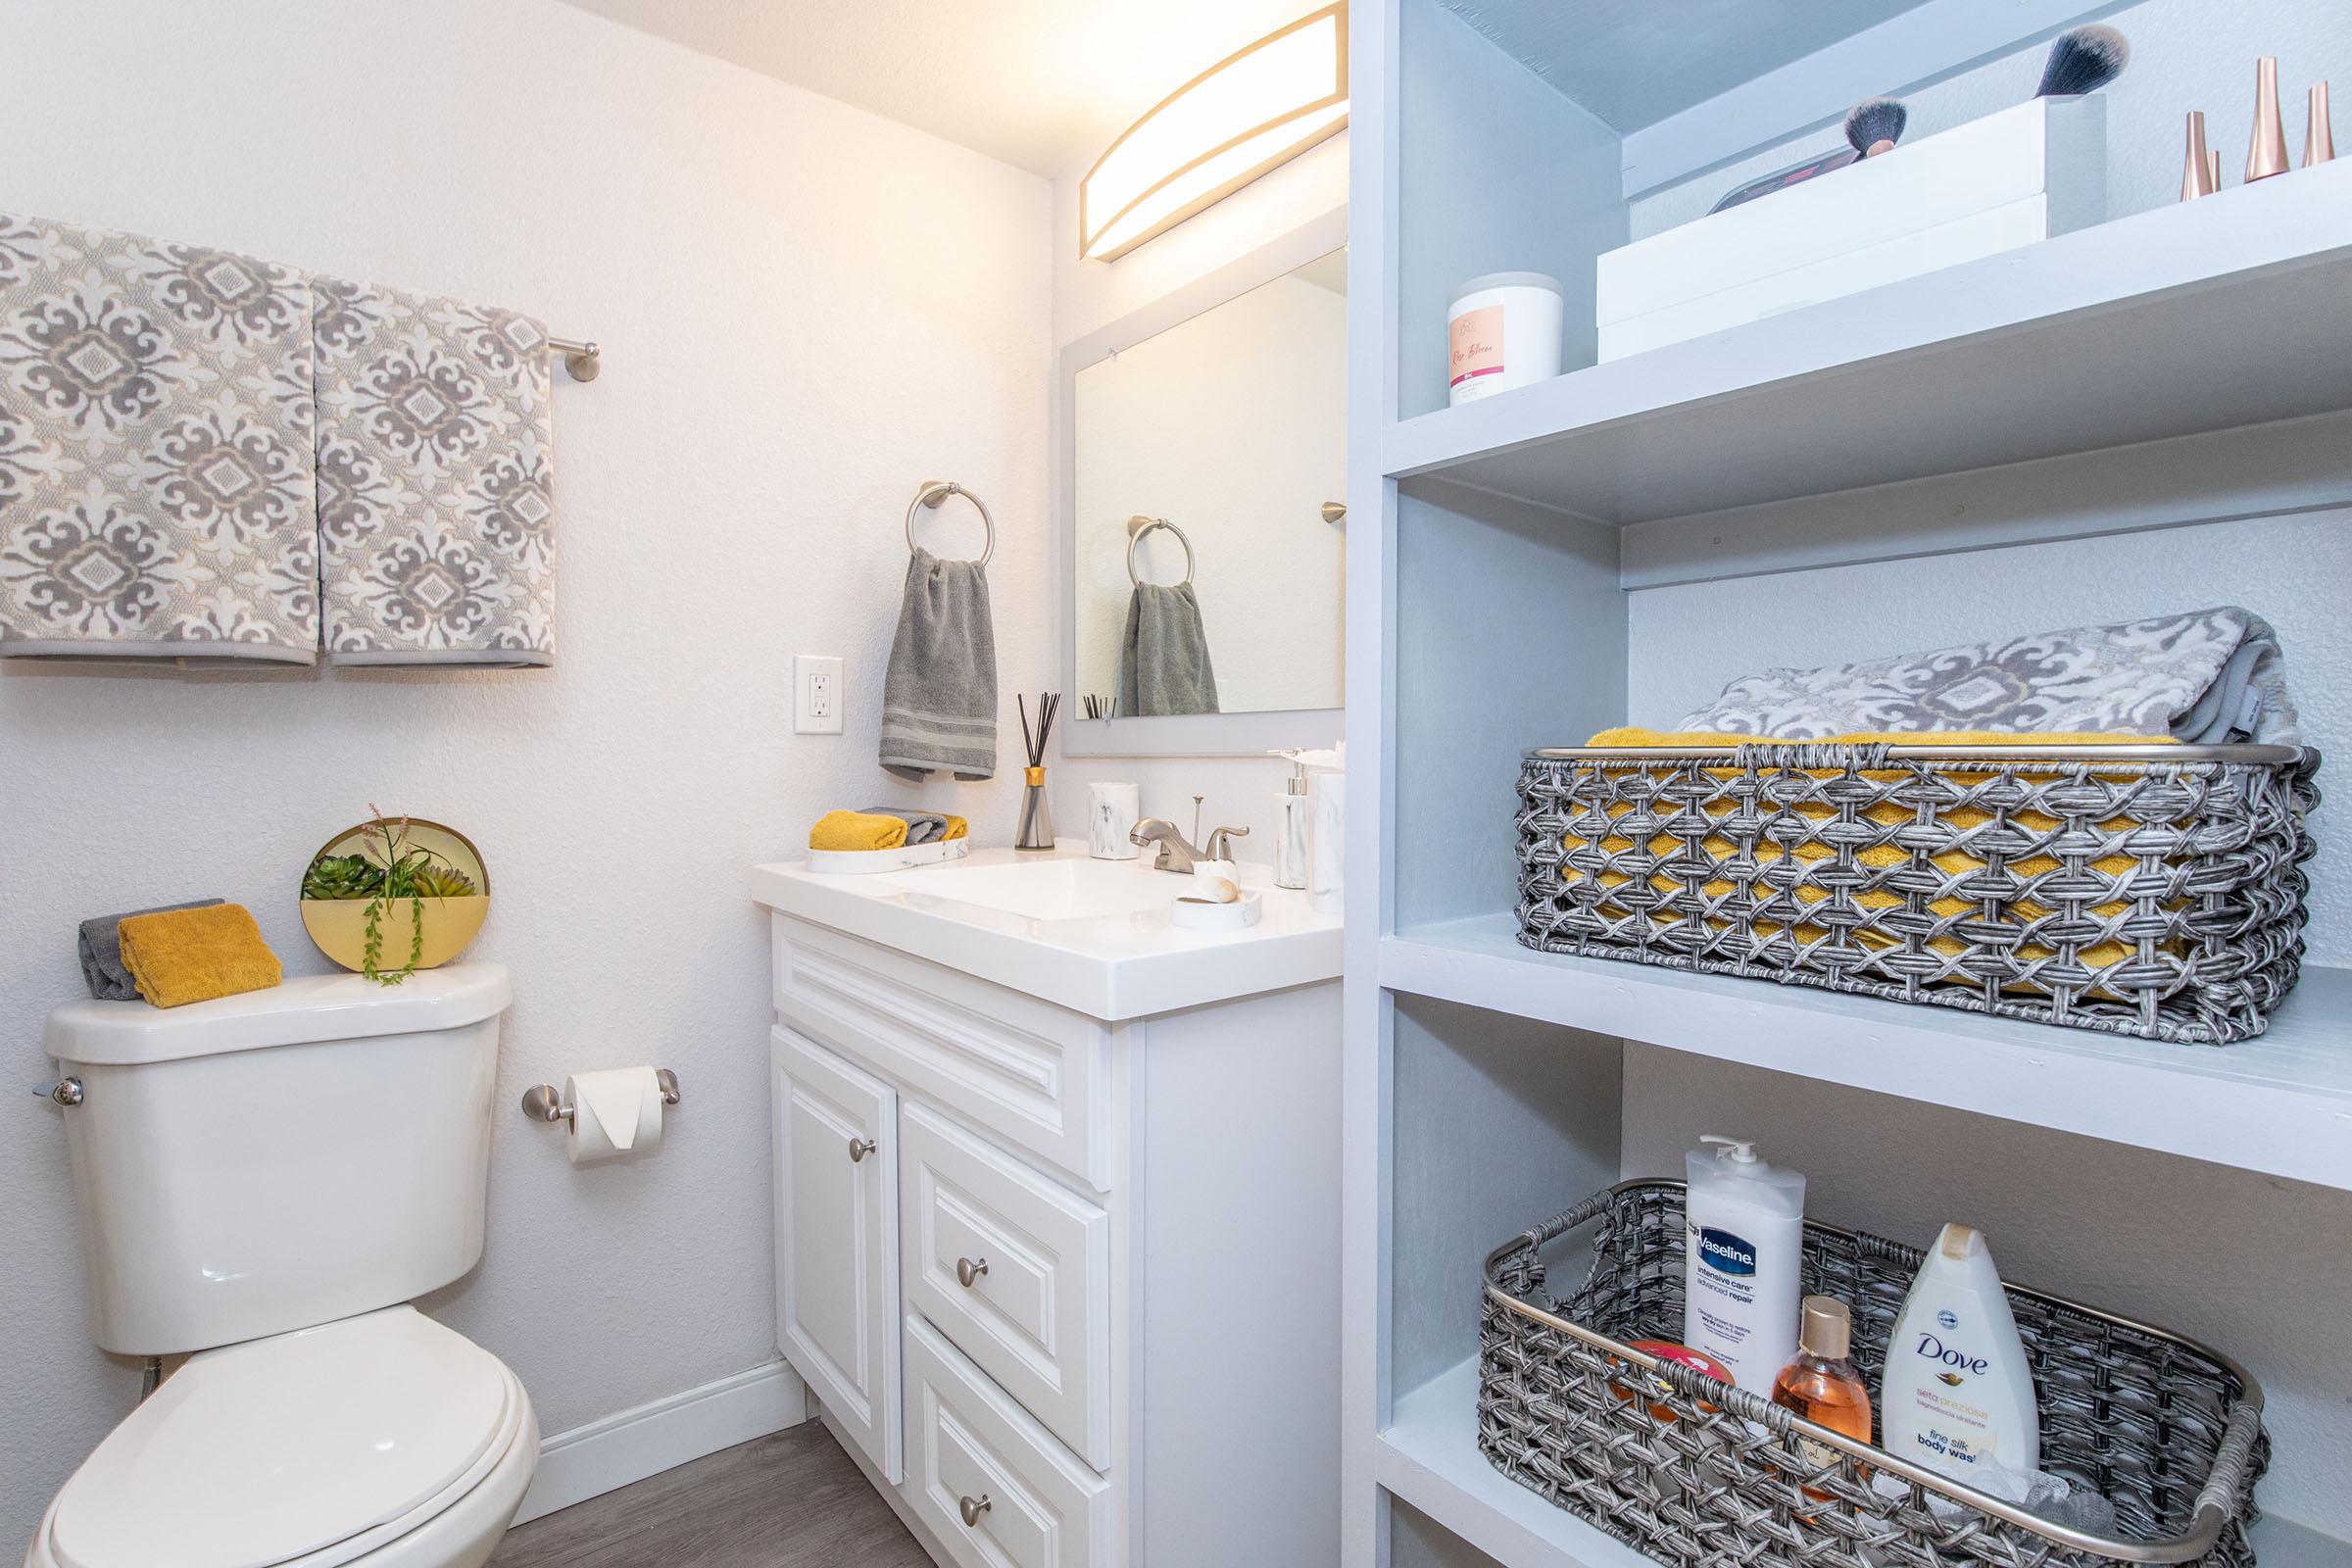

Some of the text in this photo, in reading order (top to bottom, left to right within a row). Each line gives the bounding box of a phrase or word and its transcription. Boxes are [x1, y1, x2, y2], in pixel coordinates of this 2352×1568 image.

[1697, 1265, 1731, 1286] intensive
[1697, 1278, 1753, 1304] advanced repair
[1917, 1333, 1987, 1376] Dove
[1917, 1388, 1988, 1420] seta preziosa
[1917, 1433, 1946, 1454] body
[1929, 1429, 1969, 1451] fine silk
